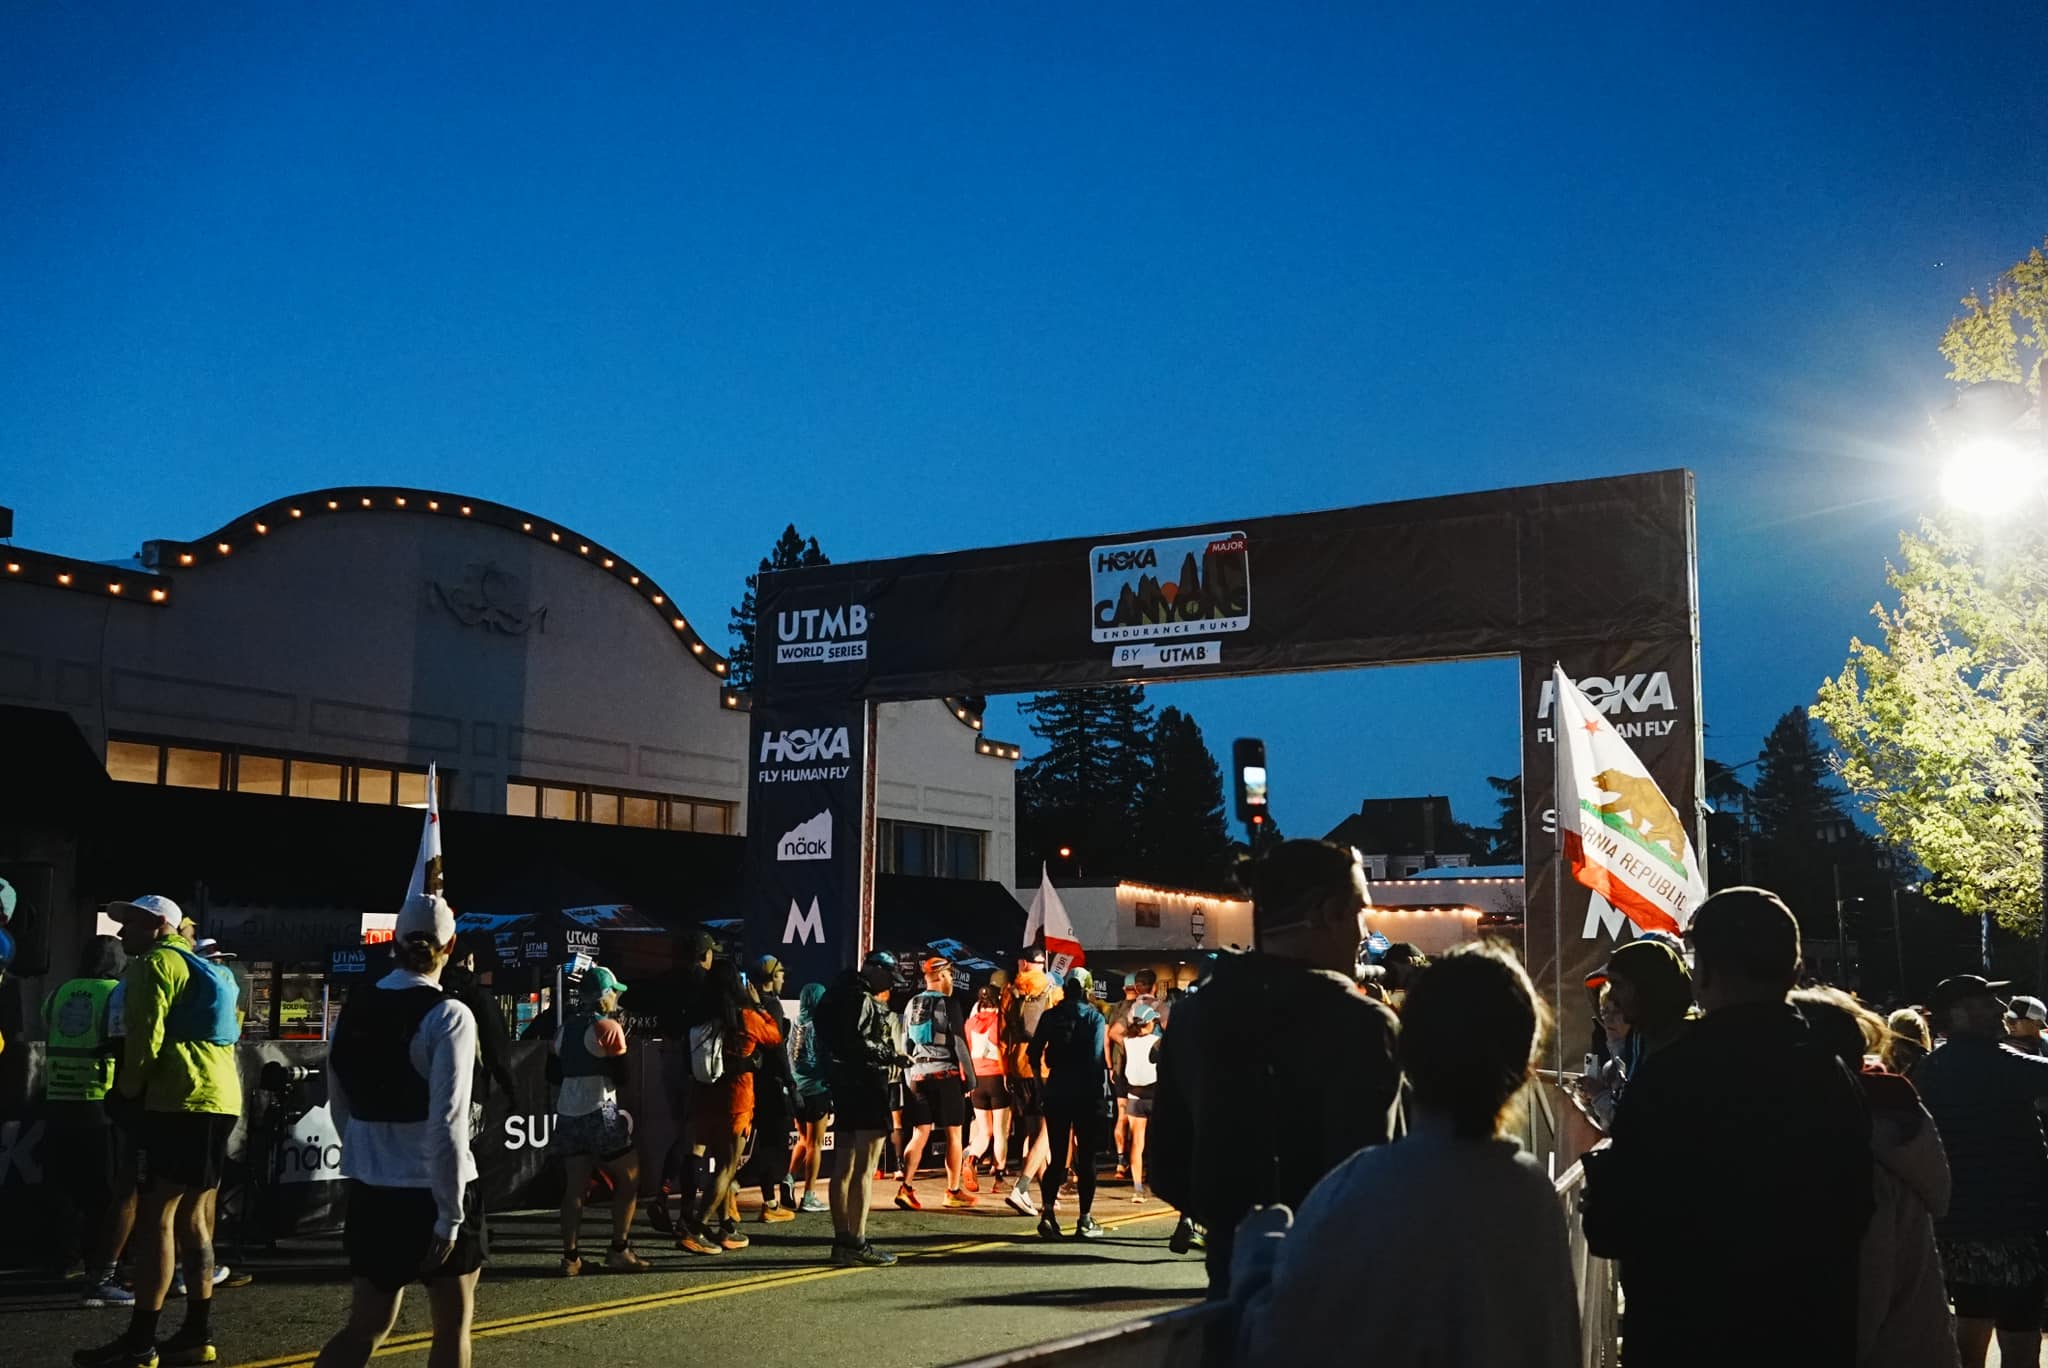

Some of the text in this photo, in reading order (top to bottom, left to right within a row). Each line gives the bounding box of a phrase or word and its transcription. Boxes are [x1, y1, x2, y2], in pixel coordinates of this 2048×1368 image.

[1212, 541, 1244, 553] MAJOR
[1098, 549, 1157, 573] HOKA
[777, 604, 869, 642] UTMB
[1103, 620, 1238, 640] ENDURANCE RUNS
[782, 645, 864, 659] WORLD SERIES
[1121, 647, 1206, 663] BY UTMB
[1645, 720, 1674, 737] FLY
[760, 727, 850, 763] HOKA
[758, 766, 850, 784] FLY HUMAN FLY
[784, 837, 826, 856] näak
[565, 930, 600, 946] UTMB
